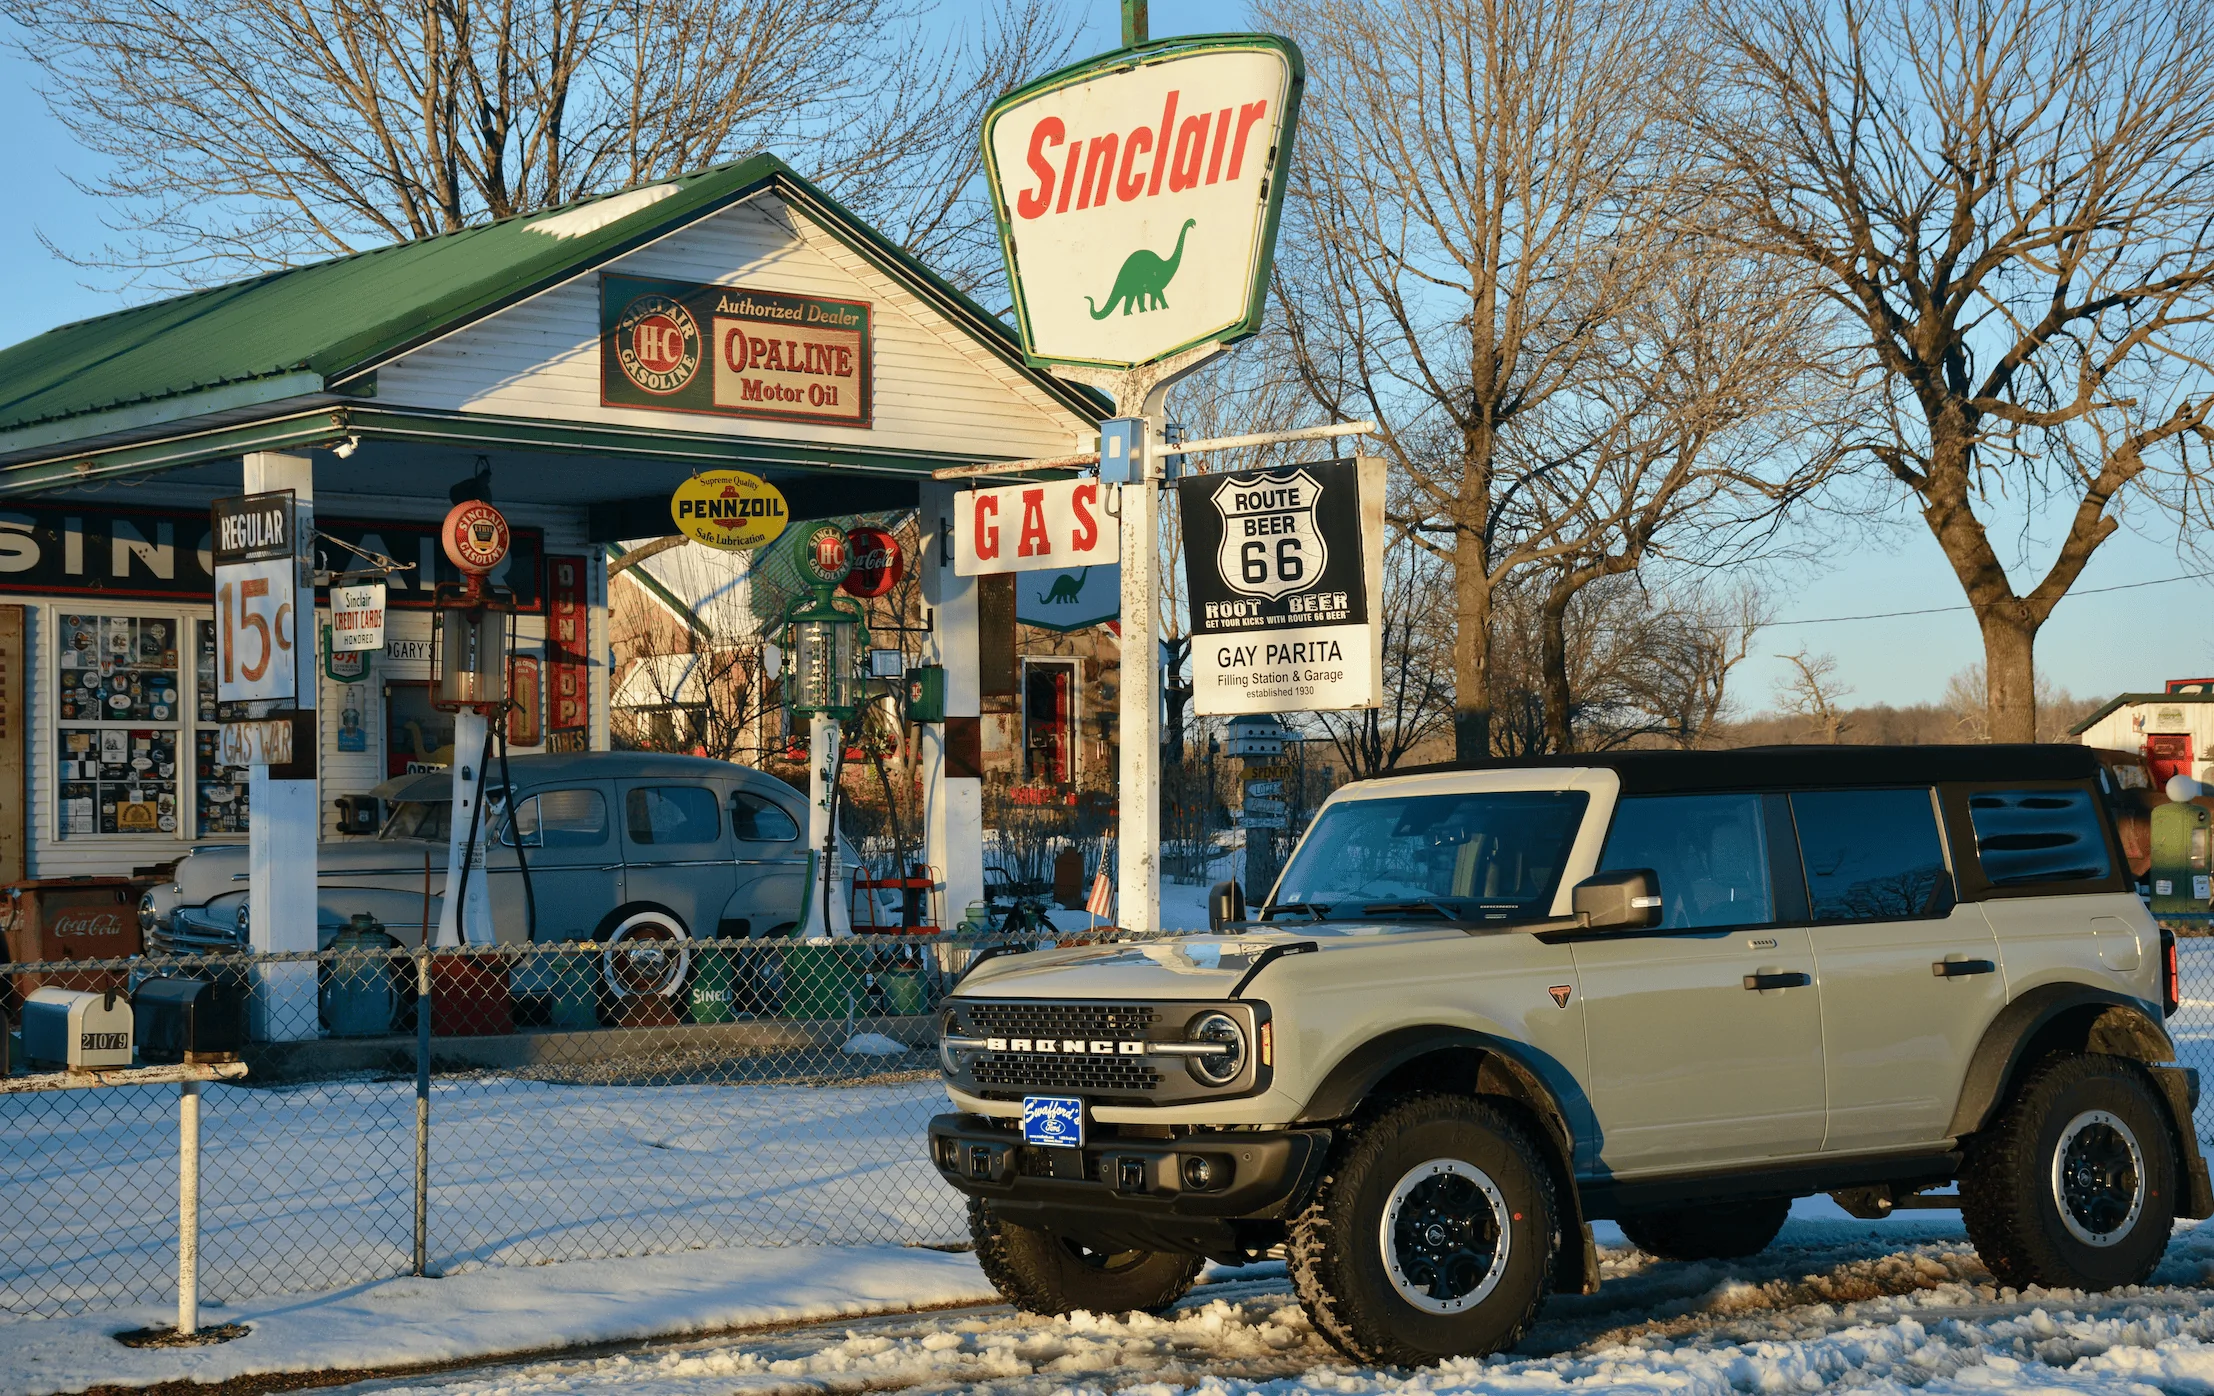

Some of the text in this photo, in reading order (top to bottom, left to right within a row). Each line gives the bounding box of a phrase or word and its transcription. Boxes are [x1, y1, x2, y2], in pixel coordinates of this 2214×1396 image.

[1017, 90, 1268, 220] Sinclair
[622, 295, 695, 340] SINCLAIR
[716, 295, 859, 327] Authorized Dealer
[724, 327, 853, 378] OPALINE
[621, 348, 696, 390] GASOLINE
[740, 378, 839, 407] Motor Oil
[700, 475, 759, 491] Supreme Quality
[679, 498, 785, 519] PENNZOIL
[1235, 487, 1301, 511] ROUTE
[221, 509, 284, 551] REGULAR
[459, 508, 505, 534] SINCLAIR
[975, 484, 1099, 561] GAS
[1244, 515, 1296, 537] BEER
[695, 527, 766, 546] Safe Lubrication
[460, 541, 505, 565] GASOLINE
[1241, 538, 1304, 585] 66
[345, 590, 371, 608] Sinclair
[1205, 591, 1349, 620] ROOT BEER
[334, 609, 382, 631] CREDIT CARDS
[1206, 619, 1218, 629] GET
[1220, 618, 1240, 628] YOUR
[1242, 617, 1265, 627] KICKS
[1267, 615, 1286, 625] WITH
[1288, 613, 1312, 624] ROUTE
[1314, 612, 1323, 622] 66
[344, 633, 374, 646] HONORED
[558, 564, 577, 724] DUNLOP
[1217, 640, 1343, 669] GAY PARITA
[1218, 669, 1344, 688] Filling Station & Garage
[1246, 685, 1314, 699] established 1930
[224, 720, 292, 764] GAS WAR
[551, 730, 585, 753] TIRES
[825, 732, 835, 804] VISIBLE
[1252, 766, 1290, 778] SPENCER
[81, 1033, 127, 1049] 21079
[987, 1037, 1144, 1055] BRONCO
[1025, 1100, 1080, 1125] Swafford's
